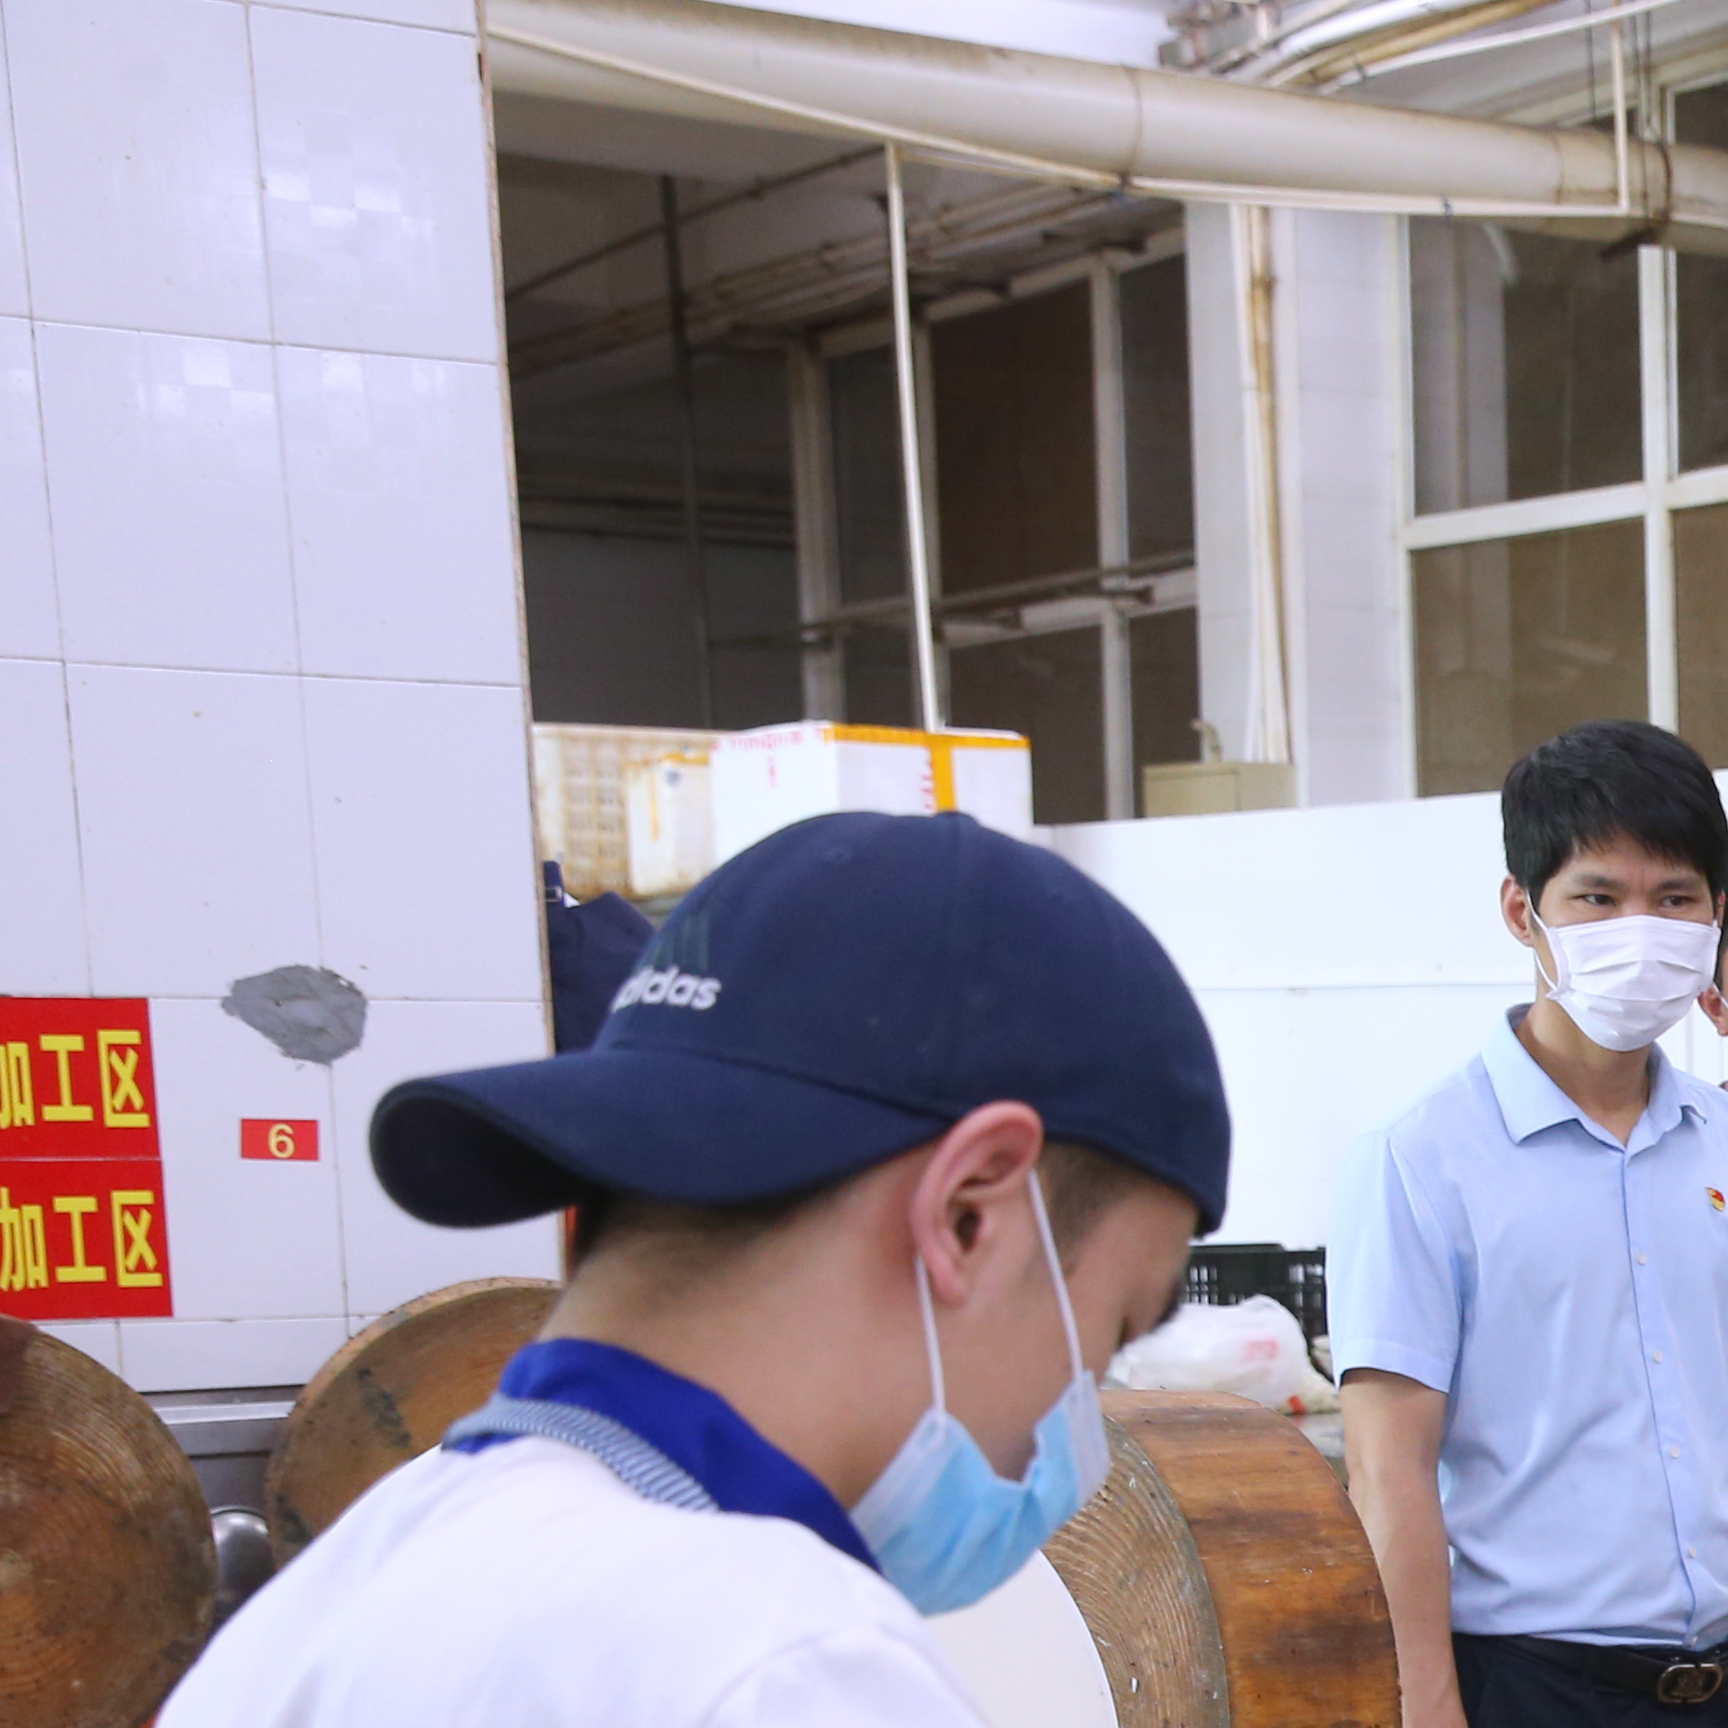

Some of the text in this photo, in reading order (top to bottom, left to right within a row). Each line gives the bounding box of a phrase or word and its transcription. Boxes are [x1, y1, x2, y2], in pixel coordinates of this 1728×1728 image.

[611, 965, 721, 1012] didas
[0, 1029, 150, 1129] 加工区
[268, 1124, 295, 1158] 6
[0, 1186, 164, 1291] 加工区
